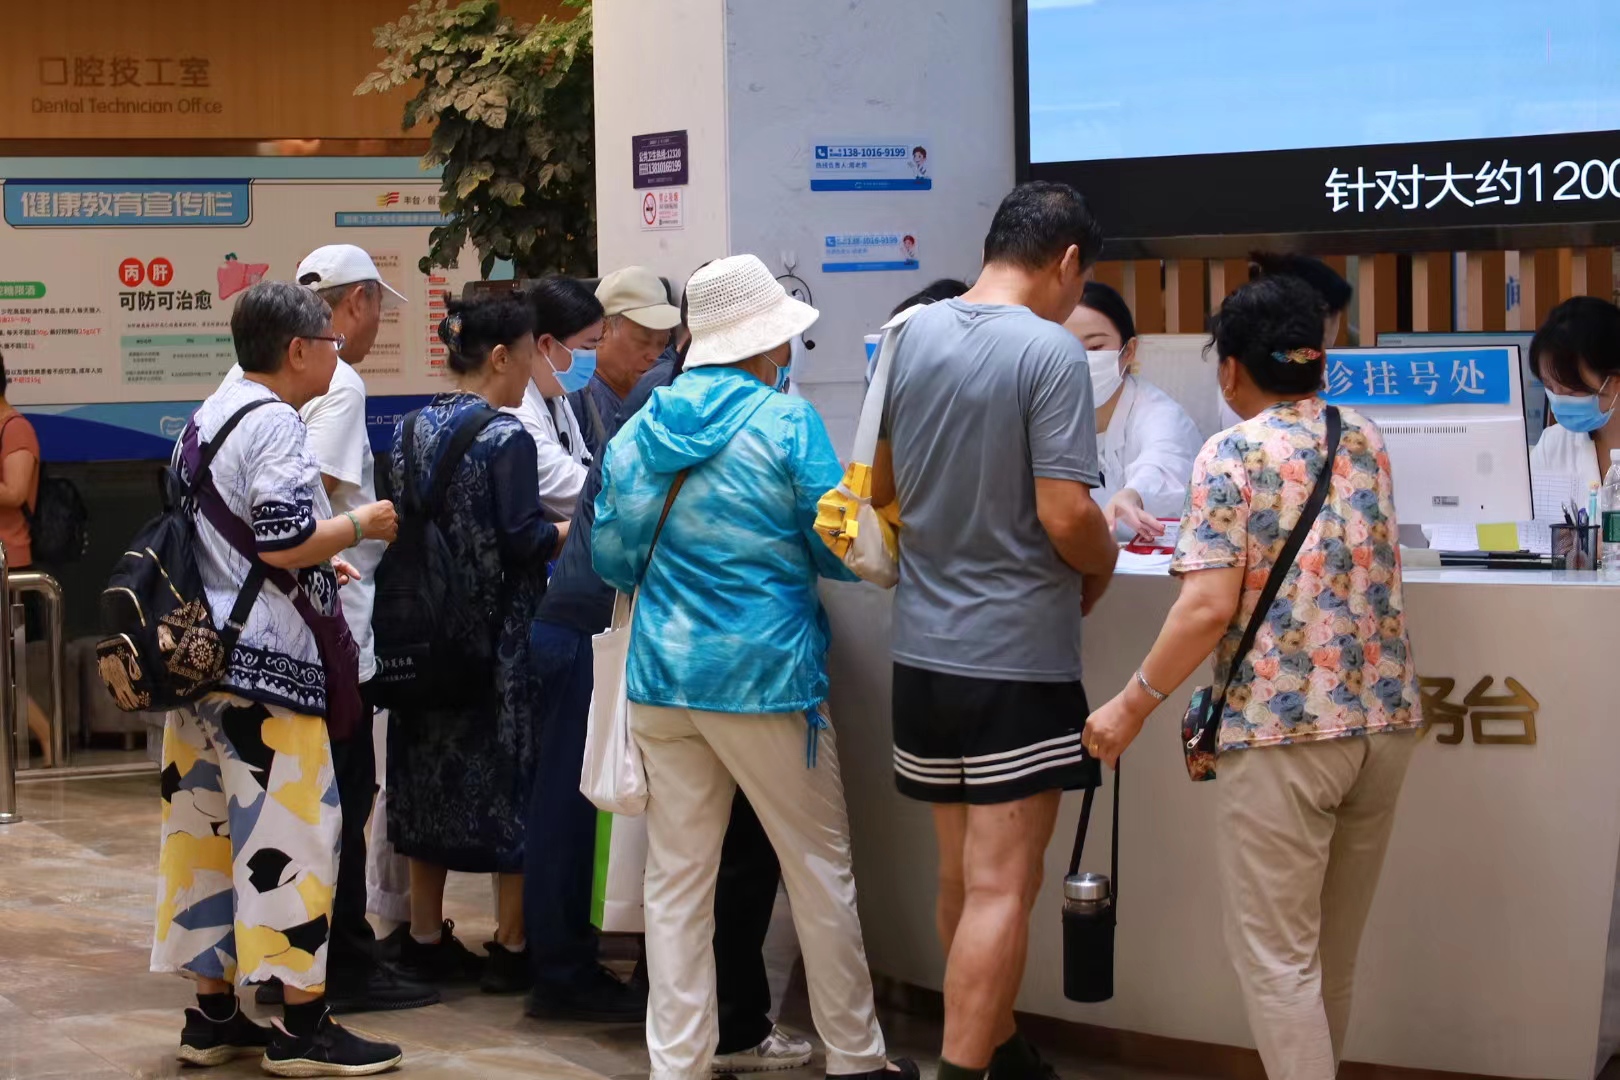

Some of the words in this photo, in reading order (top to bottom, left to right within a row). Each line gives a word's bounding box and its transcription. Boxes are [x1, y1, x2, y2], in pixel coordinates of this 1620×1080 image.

[38, 56, 211, 88] 口腔技工室
[32, 98, 84, 114] Dental
[90, 98, 174, 114] Technician
[178, 98, 223, 114] Office
[842, 148, 906, 157] 138-1016-9199
[21, 191, 233, 218] 健康教育宣传栏
[124, 264, 169, 282] 丙肝
[119, 290, 212, 311] 可防可治愈
